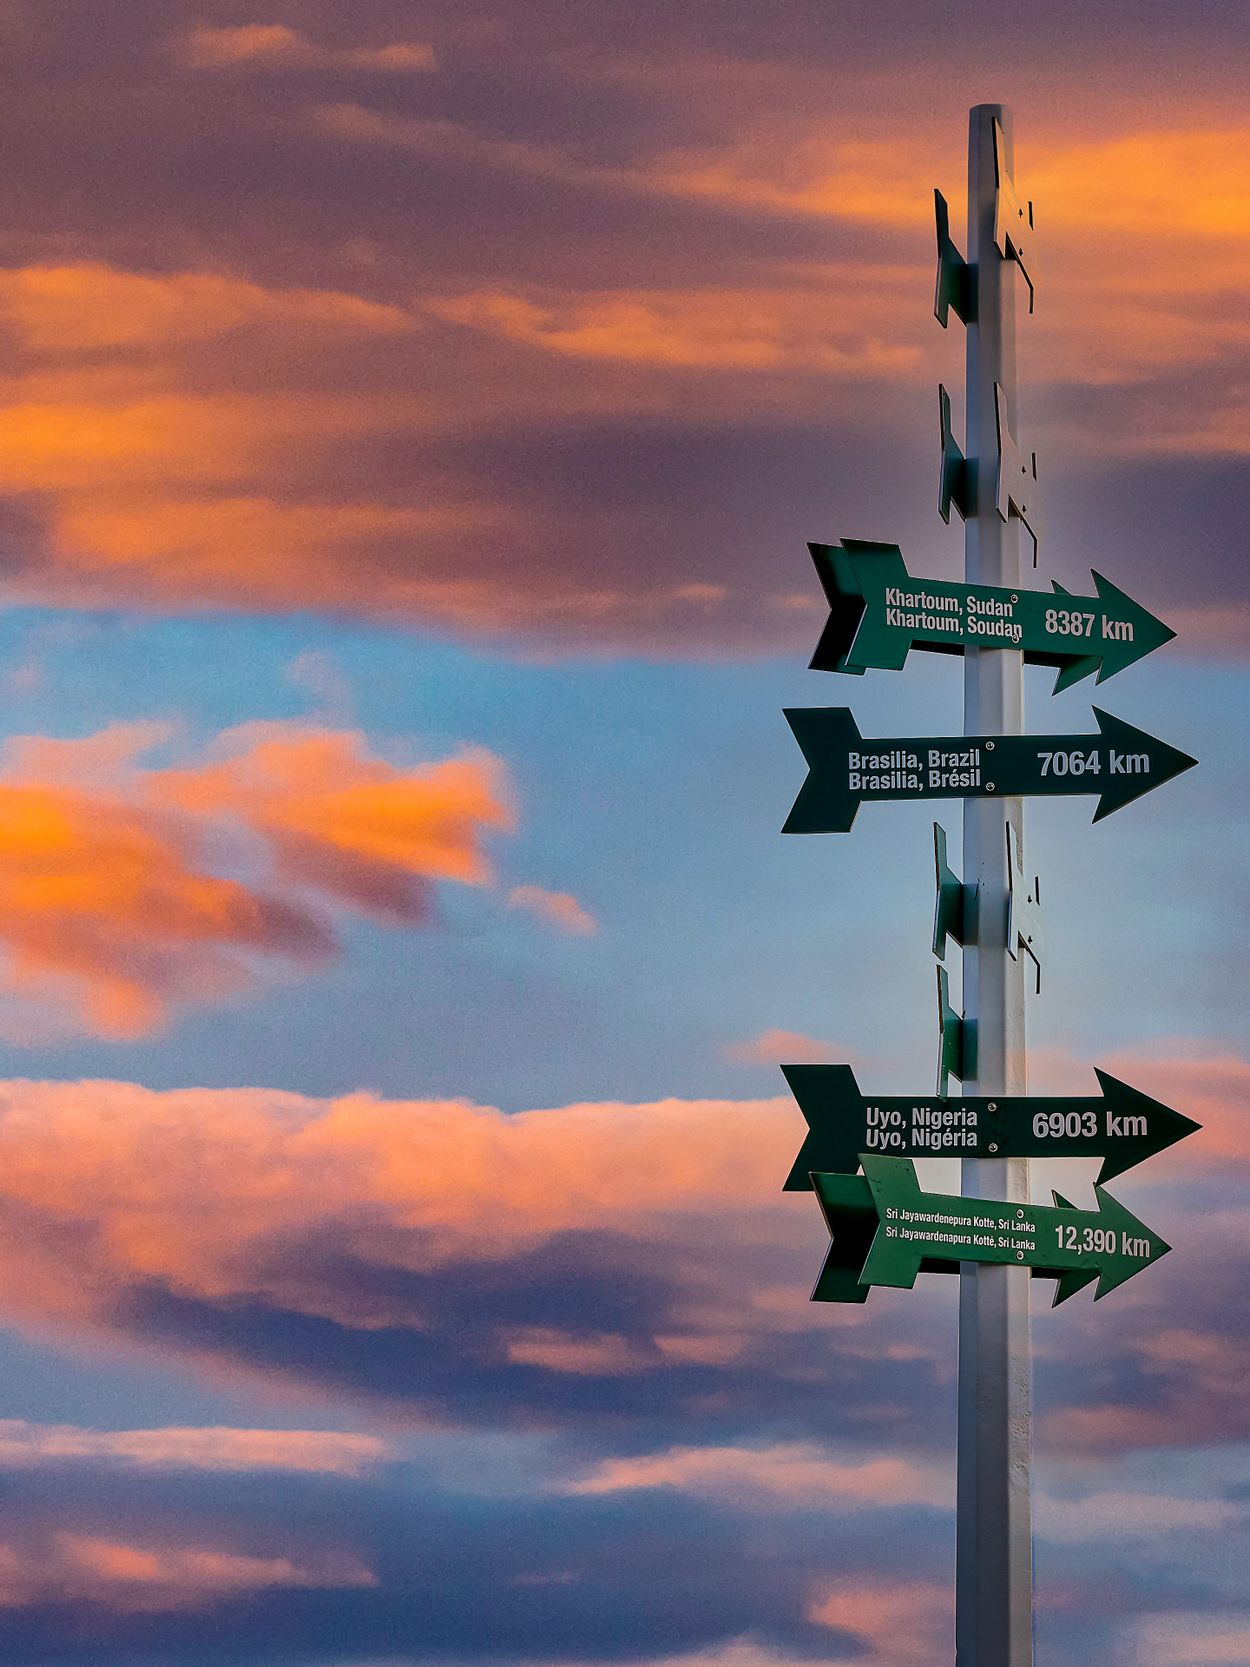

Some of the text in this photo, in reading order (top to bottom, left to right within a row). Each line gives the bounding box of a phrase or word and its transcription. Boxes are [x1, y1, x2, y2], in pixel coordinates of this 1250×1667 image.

[885, 587, 1013, 617] Khartoum, Sudan
[886, 608, 1023, 638] Khartoum, Soudan
[1045, 609, 1134, 641] 8387 km
[848, 748, 980, 771] Brasilia, Brazil
[1037, 749, 1150, 776] 7064 km
[849, 768, 981, 791] Brasilia, Brésil
[866, 1107, 978, 1129] Uyo, Nigeria
[1032, 1111, 1148, 1138] 6903 km
[866, 1127, 978, 1150] Uyo, Nigéria
[886, 1207, 1036, 1233] Sri Jayawardenepura Kotte, Sri Lanka
[886, 1226, 898, 1238] Sri
[998, 1236, 1010, 1248] Sri
[1011, 1238, 1036, 1251] Lanka
[1055, 1224, 1150, 1258] 12,390 km
